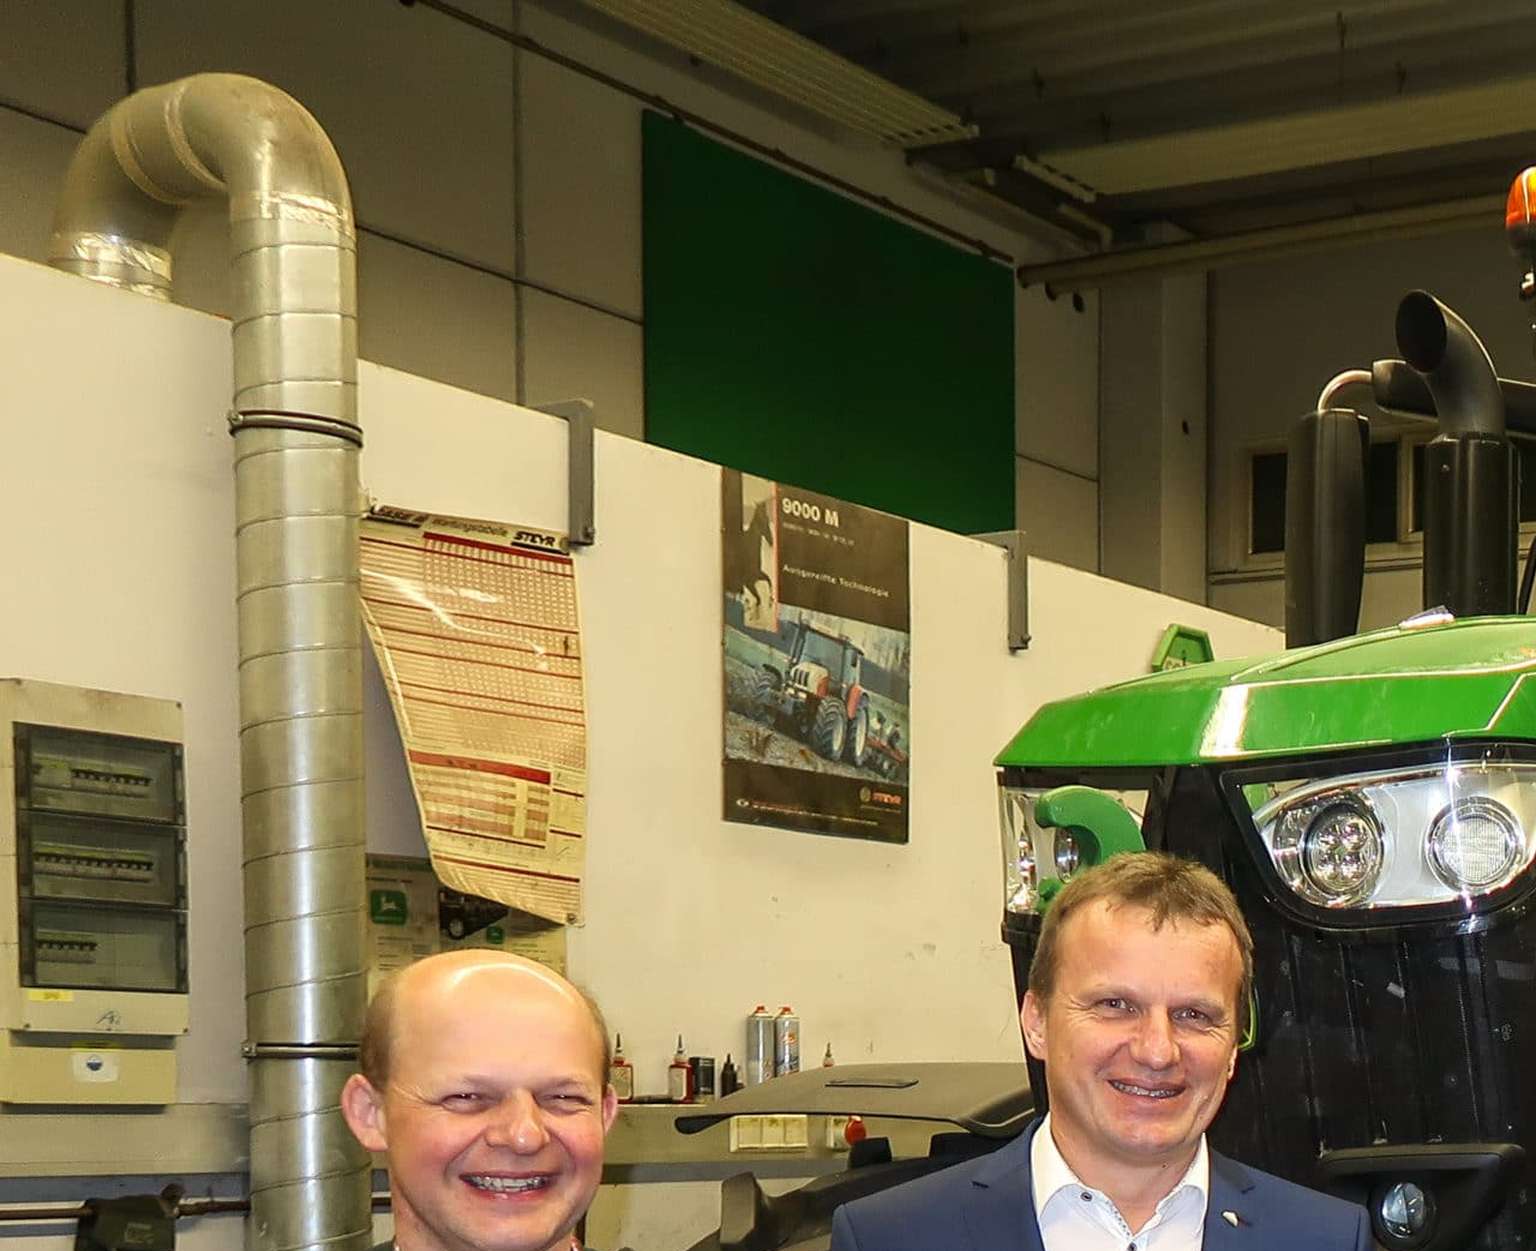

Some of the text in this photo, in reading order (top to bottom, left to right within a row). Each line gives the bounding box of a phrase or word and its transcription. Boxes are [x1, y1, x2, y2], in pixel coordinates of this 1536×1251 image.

[782, 497, 839, 528] 9000 M
[513, 530, 556, 546] STEYR
